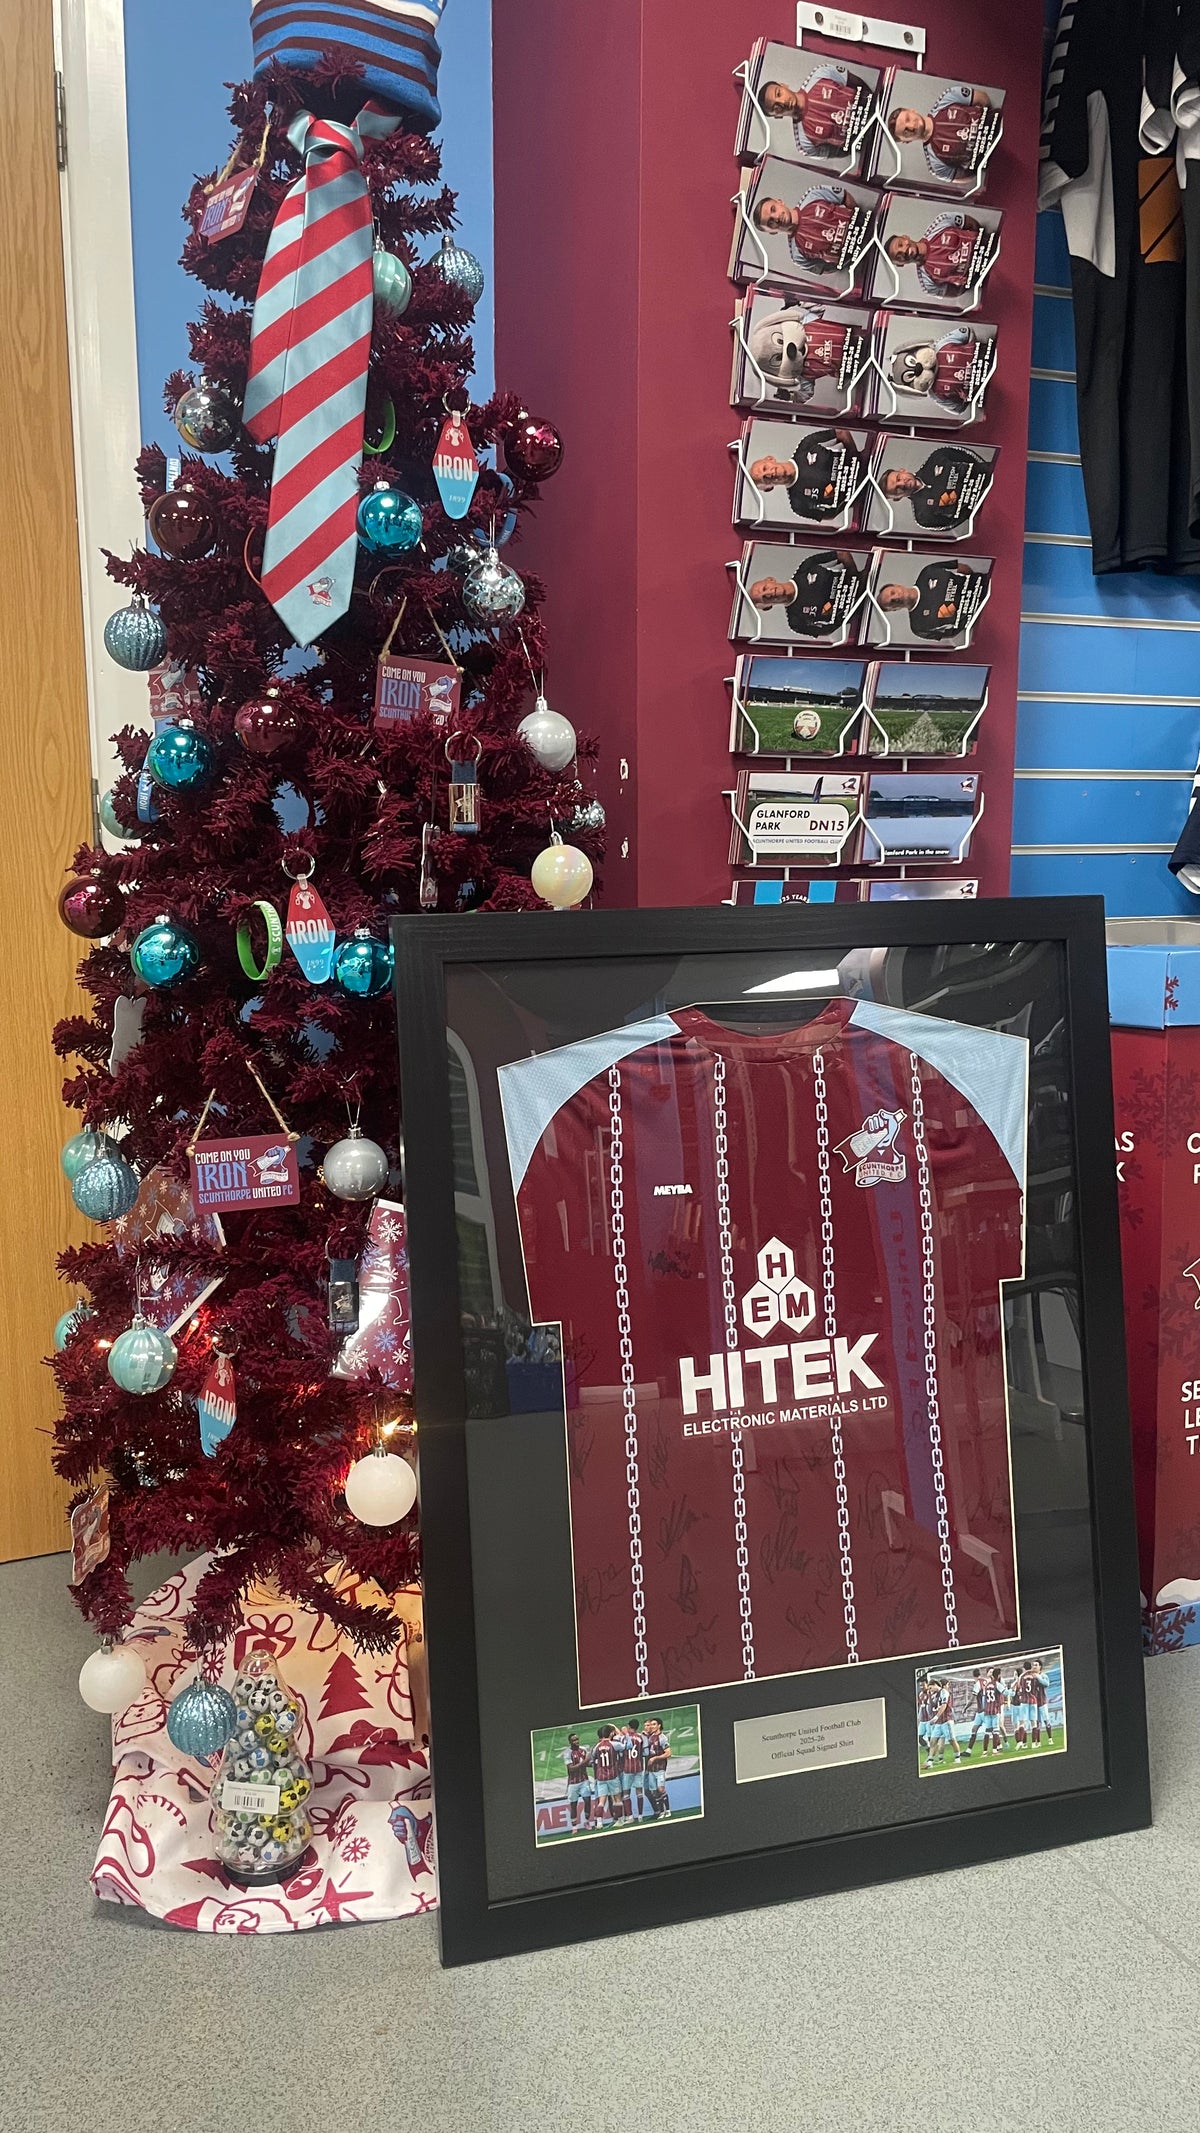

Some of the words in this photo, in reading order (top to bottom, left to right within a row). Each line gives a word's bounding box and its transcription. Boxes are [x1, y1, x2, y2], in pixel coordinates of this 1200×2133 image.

[843, 111, 856, 151] Scunthorpe
[852, 86, 862, 110] United
[853, 106, 863, 134] 2025-26
[861, 93, 873, 125] Starbuck
[969, 131, 982, 170] Scunthorpe
[978, 107, 988, 130] United
[979, 125, 989, 153] 2025-26
[987, 112, 999, 140] Dawson
[830, 219, 846, 254] HITEK
[836, 231, 852, 270] Scunthorpe
[848, 207, 860, 230] United
[847, 226, 860, 254] 2025-26
[857, 210, 872, 244] Chadwick
[965, 251, 977, 288] Scunthorpe
[974, 227, 984, 250] United
[984, 232, 995, 257] Denton
[974, 246, 985, 272] 2025-26
[823, 340, 832, 364] HITEK
[837, 351, 848, 390] Scunthorpe
[843, 327, 852, 350] United
[846, 346, 854, 373] 2025-26
[854, 336, 864, 359] Bunny
[967, 365, 976, 402] Scunthorpe
[972, 342, 980, 364] United
[975, 359, 983, 385] 2025-26
[437, 453, 473, 482] IRON
[832, 471, 842, 508] Scunthorpe
[838, 448, 847, 470] United
[840, 465, 849, 492] 2025-26
[811, 487, 819, 499] JS
[954, 484, 967, 518] Scunthorpe
[963, 462, 974, 483] United
[964, 478, 975, 503] 2025-26
[830, 590, 841, 624] Scunthorpe
[837, 568, 847, 588] United
[838, 584, 848, 609] 2025-26
[953, 595, 965, 629] Scunthorpe
[961, 574, 971, 594] United
[962, 589, 973, 614] 2025-26
[381, 666, 401, 679] COME
[401, 669, 412, 680] ON
[412, 671, 426, 683] YOU
[380, 678, 420, 709] IRON
[139, 792, 149, 810] IRON
[756, 810, 810, 819] GLANFORD
[755, 822, 781, 831] PARK
[809, 820, 844, 831] DN15
[290, 918, 330, 945] IRON
[195, 1151, 219, 1164] COME
[220, 1150, 232, 1162] ON
[233, 1149, 250, 1161] YOU
[196, 1161, 248, 1191] IRON
[198, 1189, 251, 1204] SCUNTHORPE
[252, 1185, 282, 1198] UNITED
[653, 1184, 693, 1196] MEYBA
[765, 1252, 786, 1279] H
[751, 1297, 771, 1324] E
[787, 1291, 810, 1318] M
[679, 1333, 885, 1415] HITEK
[203, 1389, 233, 1426] IRON
[683, 1412, 776, 1437] ELECTRONIC
[779, 1399, 858, 1423] MATERIALS
[862, 1395, 888, 1411] LTD
[986, 1689, 996, 1702] 33
[1025, 1680, 1032, 1692] 3
[761, 1731, 797, 1742] Scunthorpe
[798, 1727, 819, 1735] United
[820, 1722, 845, 1733] Football
[846, 1719, 861, 1727] Club
[800, 1735, 825, 1745] 2025-26
[600, 1752, 610, 1767] 11
[628, 1744, 638, 1759] 16
[771, 1750, 795, 1760] Official
[796, 1745, 815, 1755] Squad
[817, 1743, 838, 1752] Signed
[839, 1739, 854, 1748] Shirt
